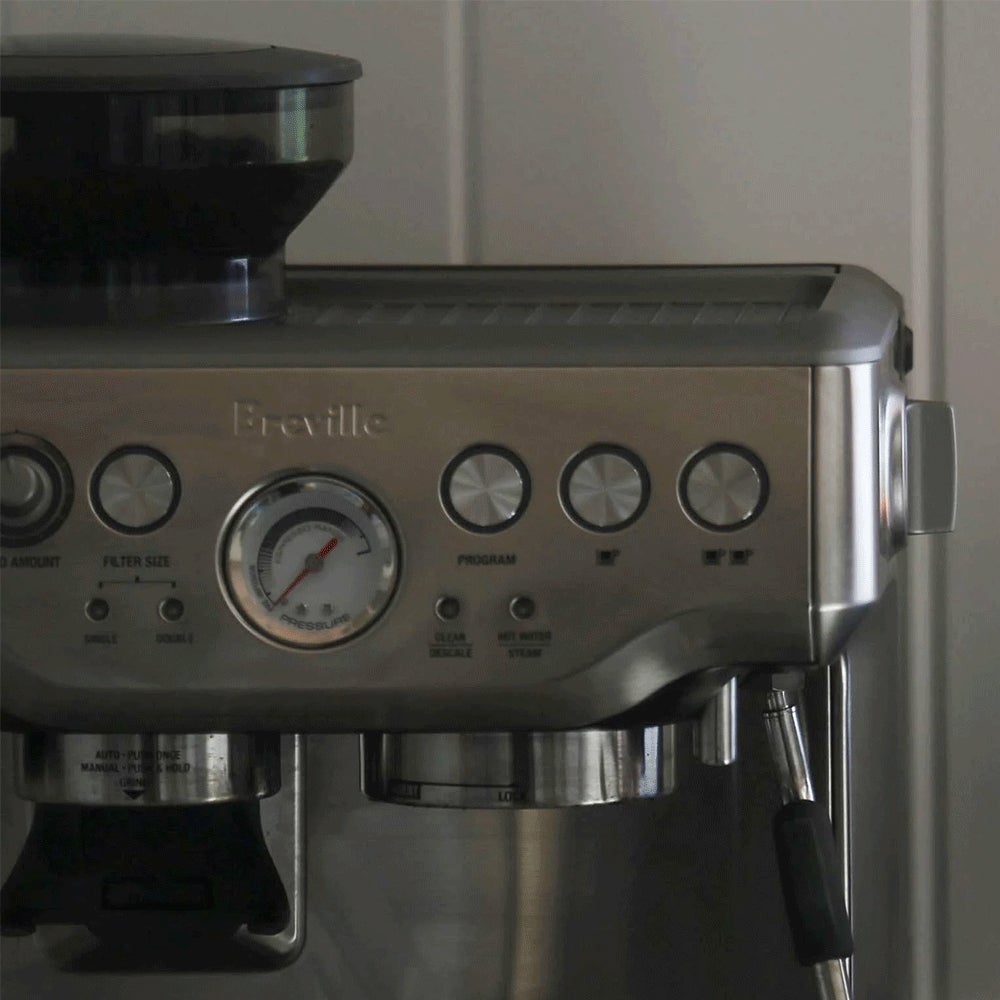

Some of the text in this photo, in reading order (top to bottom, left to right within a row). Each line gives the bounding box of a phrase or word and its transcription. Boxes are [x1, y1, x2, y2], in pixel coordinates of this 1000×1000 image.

[234, 400, 387, 437] Breville
[11, 556, 61, 568] AMOUNT
[103, 556, 170, 568] FILTER SIZE
[457, 554, 517, 566] PROGRAM
[280, 613, 351, 630] PRESSURE
[95, 750, 120, 760] AUTO
[80, 763, 120, 773] MANUAL
[120, 777, 150, 788] GRIN
